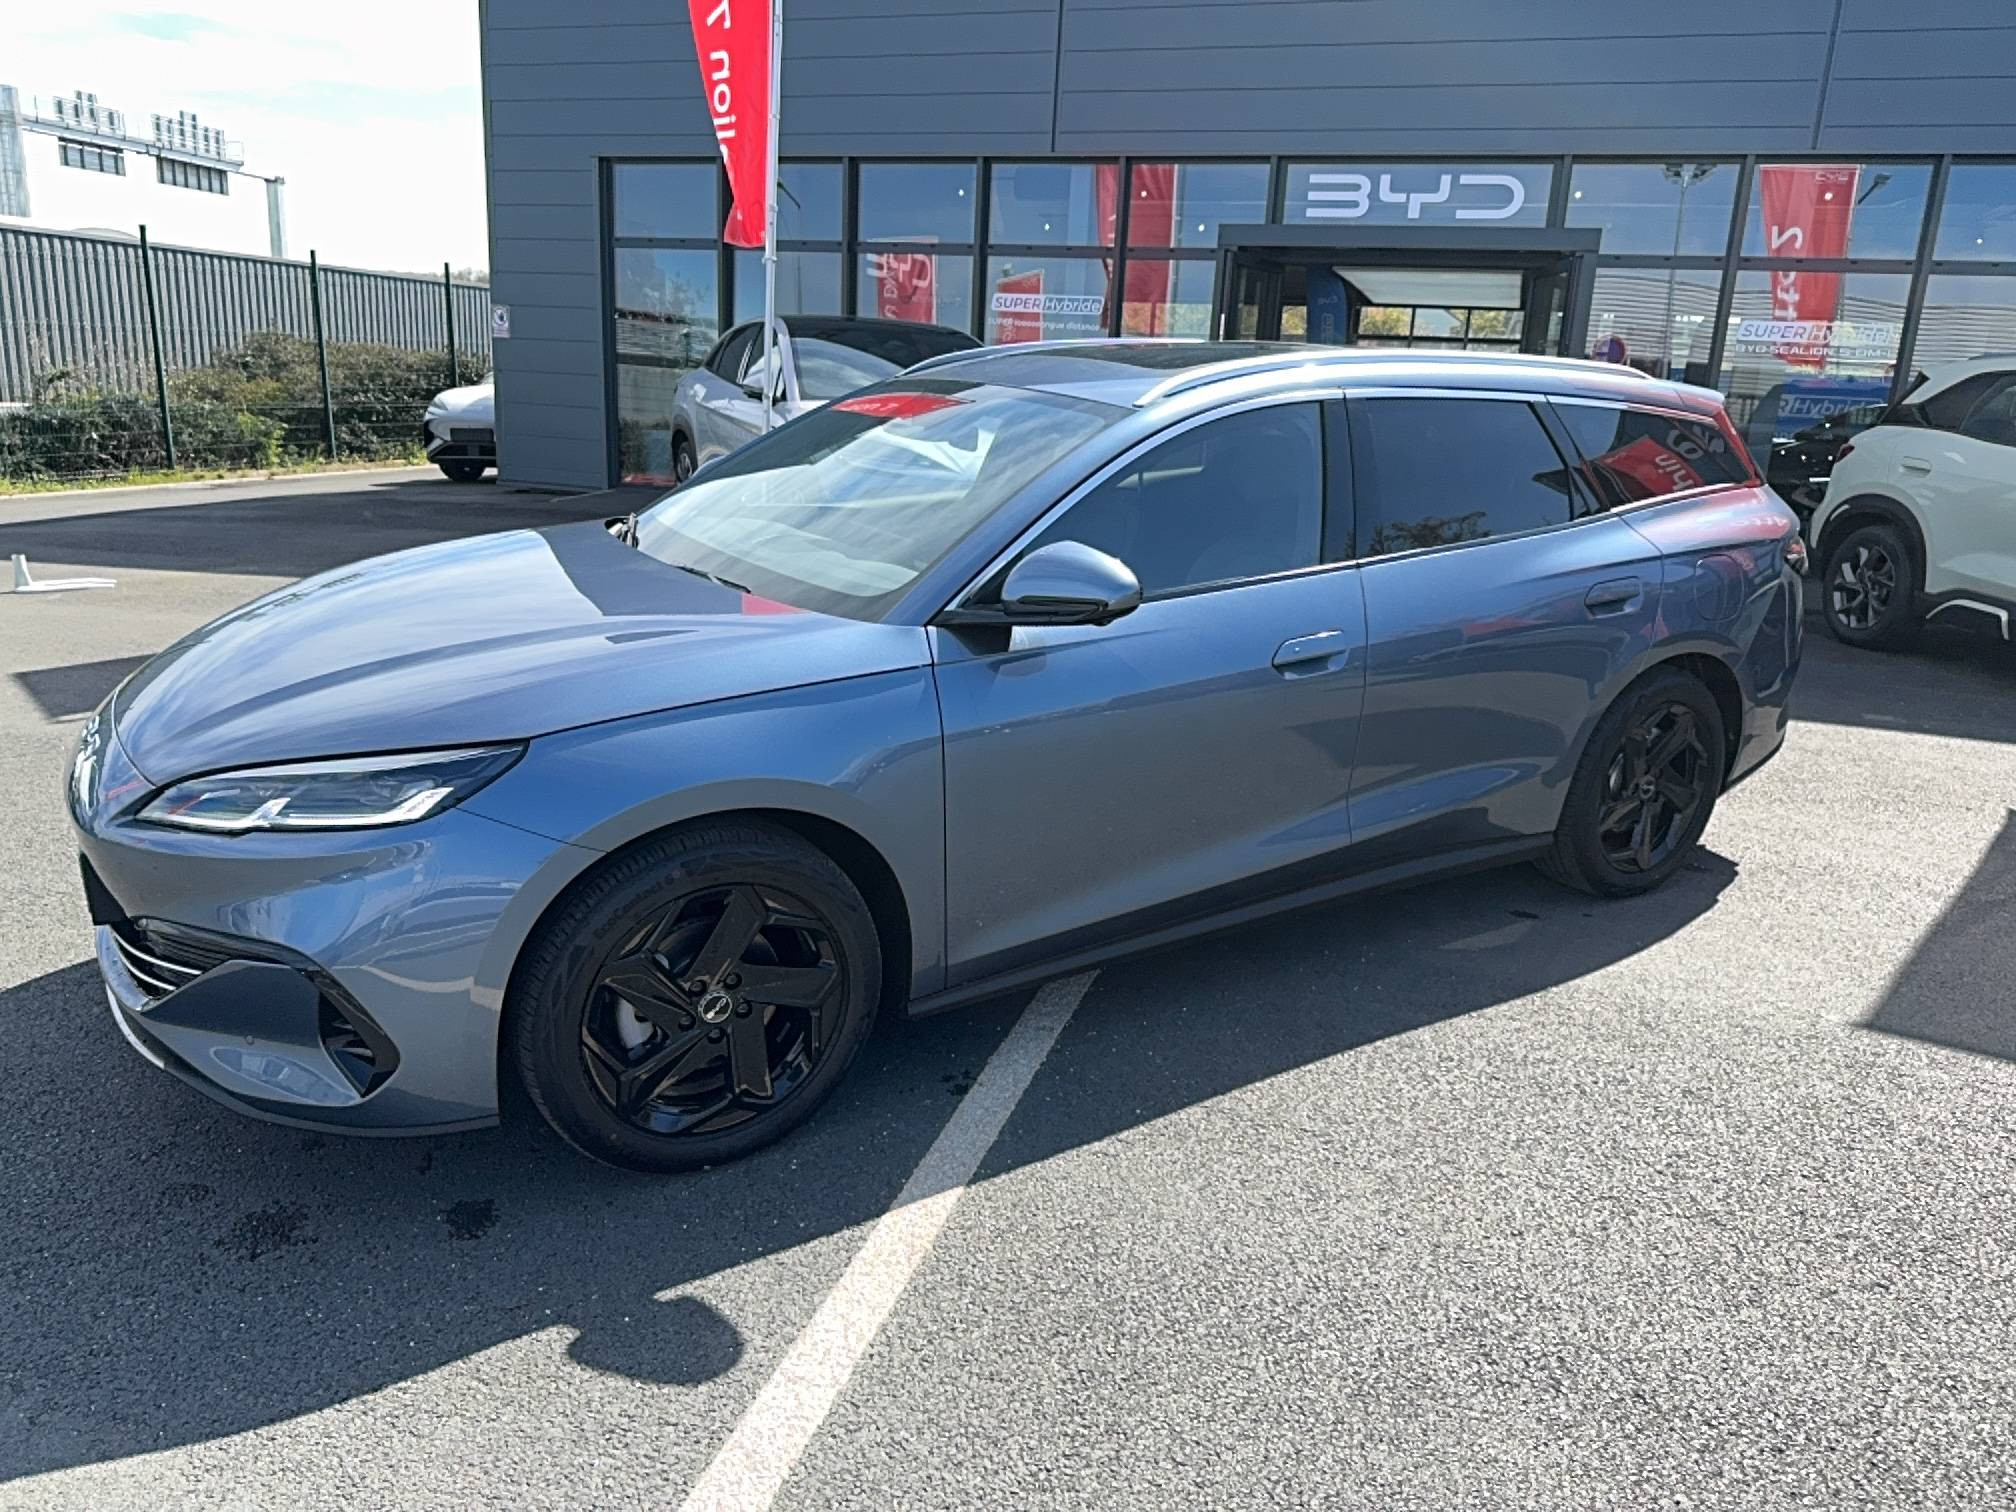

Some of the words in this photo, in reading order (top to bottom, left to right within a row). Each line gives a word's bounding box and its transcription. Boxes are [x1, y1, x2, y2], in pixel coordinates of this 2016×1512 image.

[1305, 173, 1525, 220] BYD
[995, 296, 1042, 309] SUPER
[1045, 298, 1101, 313] Hybride
[1741, 323, 1807, 339] SUPER
[1769, 344, 1831, 356] SEALION
